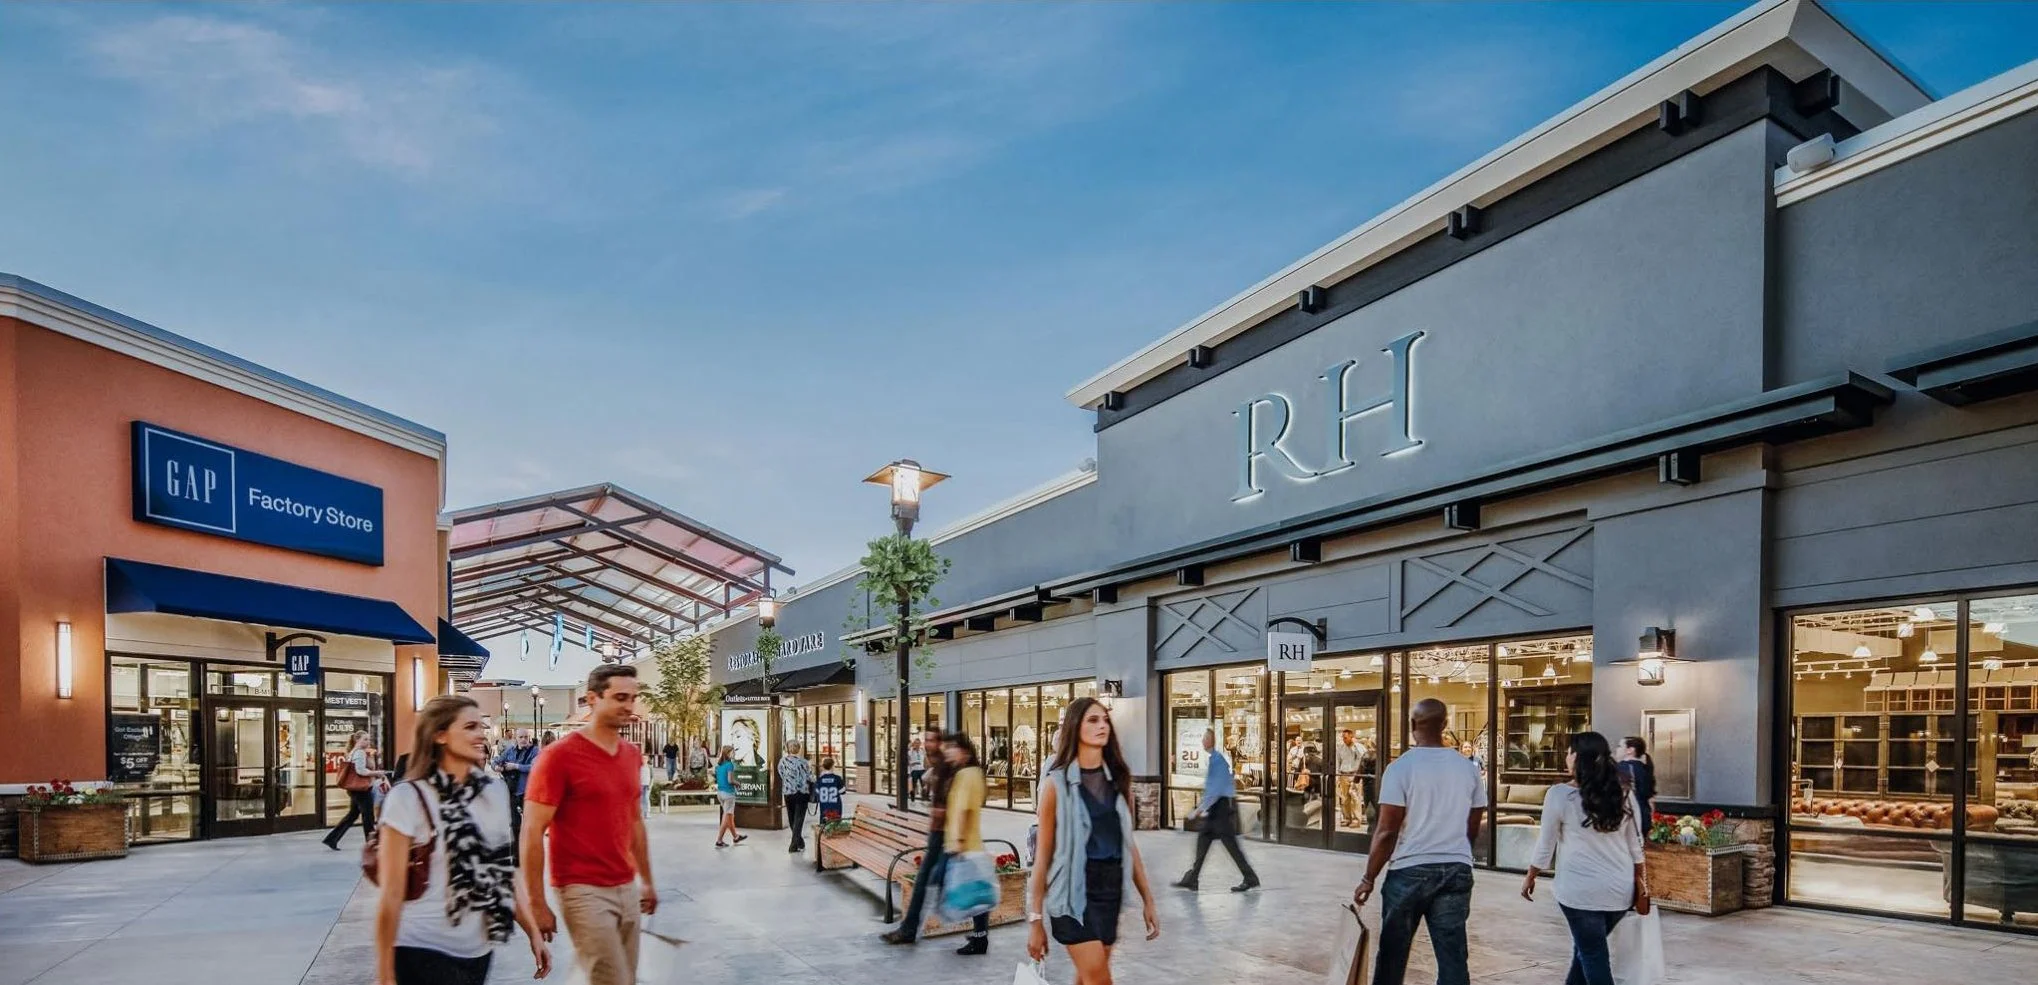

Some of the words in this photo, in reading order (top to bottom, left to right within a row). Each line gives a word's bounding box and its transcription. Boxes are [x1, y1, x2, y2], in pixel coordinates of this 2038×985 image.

[1230, 330, 1426, 502] RH
[166, 460, 217, 504] GAP
[248, 487, 323, 524] Factory
[326, 506, 374, 532] Store
[1279, 643, 1305, 660] RH
[292, 655, 309, 671] GAP
[725, 694, 746, 703] Outlets
[120, 757, 135, 769] $5
[820, 786, 838, 803] 82
